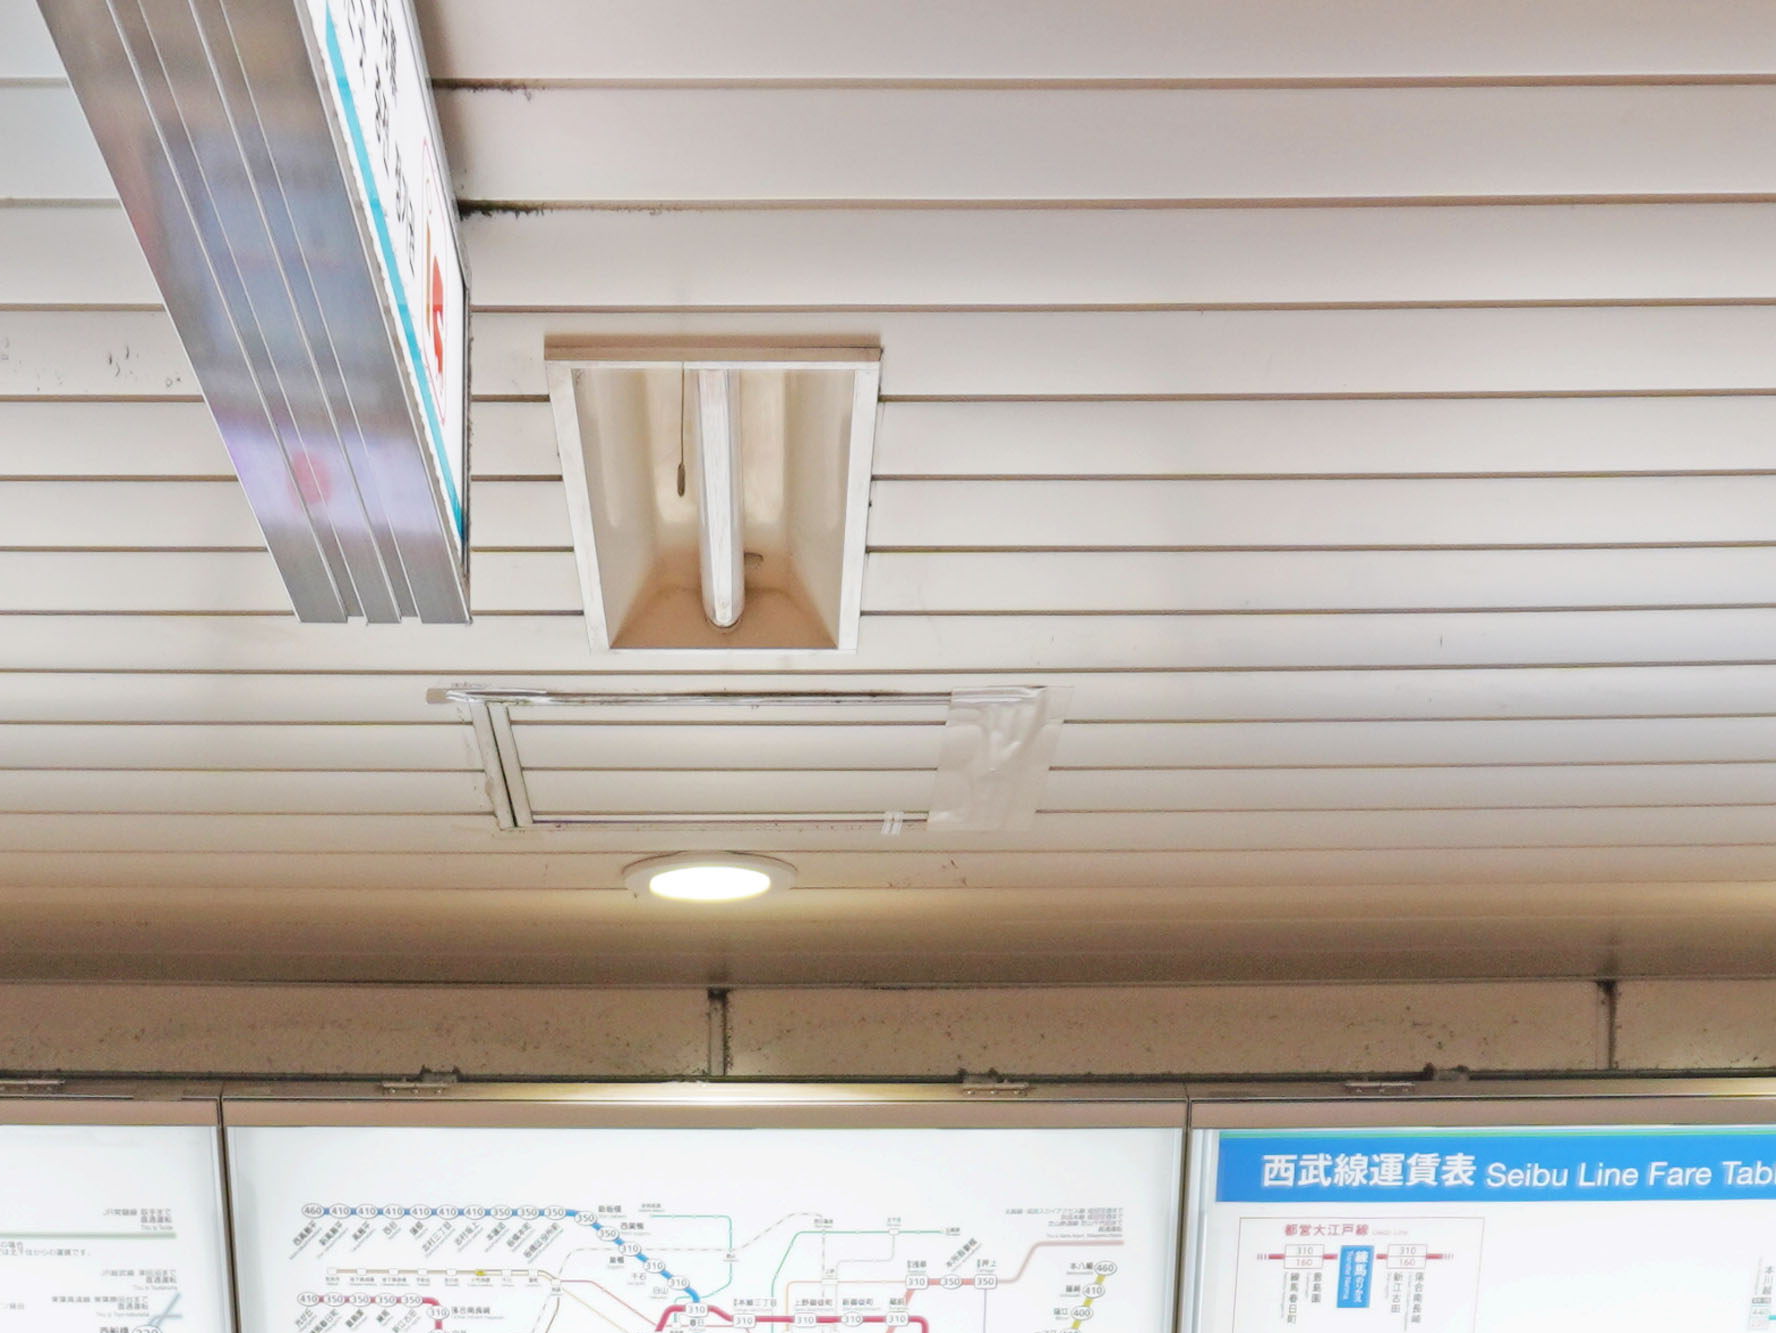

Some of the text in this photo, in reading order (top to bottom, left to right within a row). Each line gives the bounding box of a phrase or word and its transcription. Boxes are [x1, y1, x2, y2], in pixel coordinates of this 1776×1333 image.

[1262, 1152, 1475, 1188] 西武線運賃表
[1487, 1163, 1568, 1189] Seibu
[1579, 1162, 1638, 1187] Line
[1649, 1161, 1711, 1186] Fare
[304, 1206, 321, 1216] 460
[493, 1208, 510, 1218] 350
[1284, 1223, 1369, 1237] 都営大江戸線
[1097, 1264, 1114, 1273] 460
[978, 1277, 993, 1286] 350
[300, 1295, 317, 1304] 410
[430, 1309, 447, 1318] 310
[797, 1316, 814, 1325] 310
